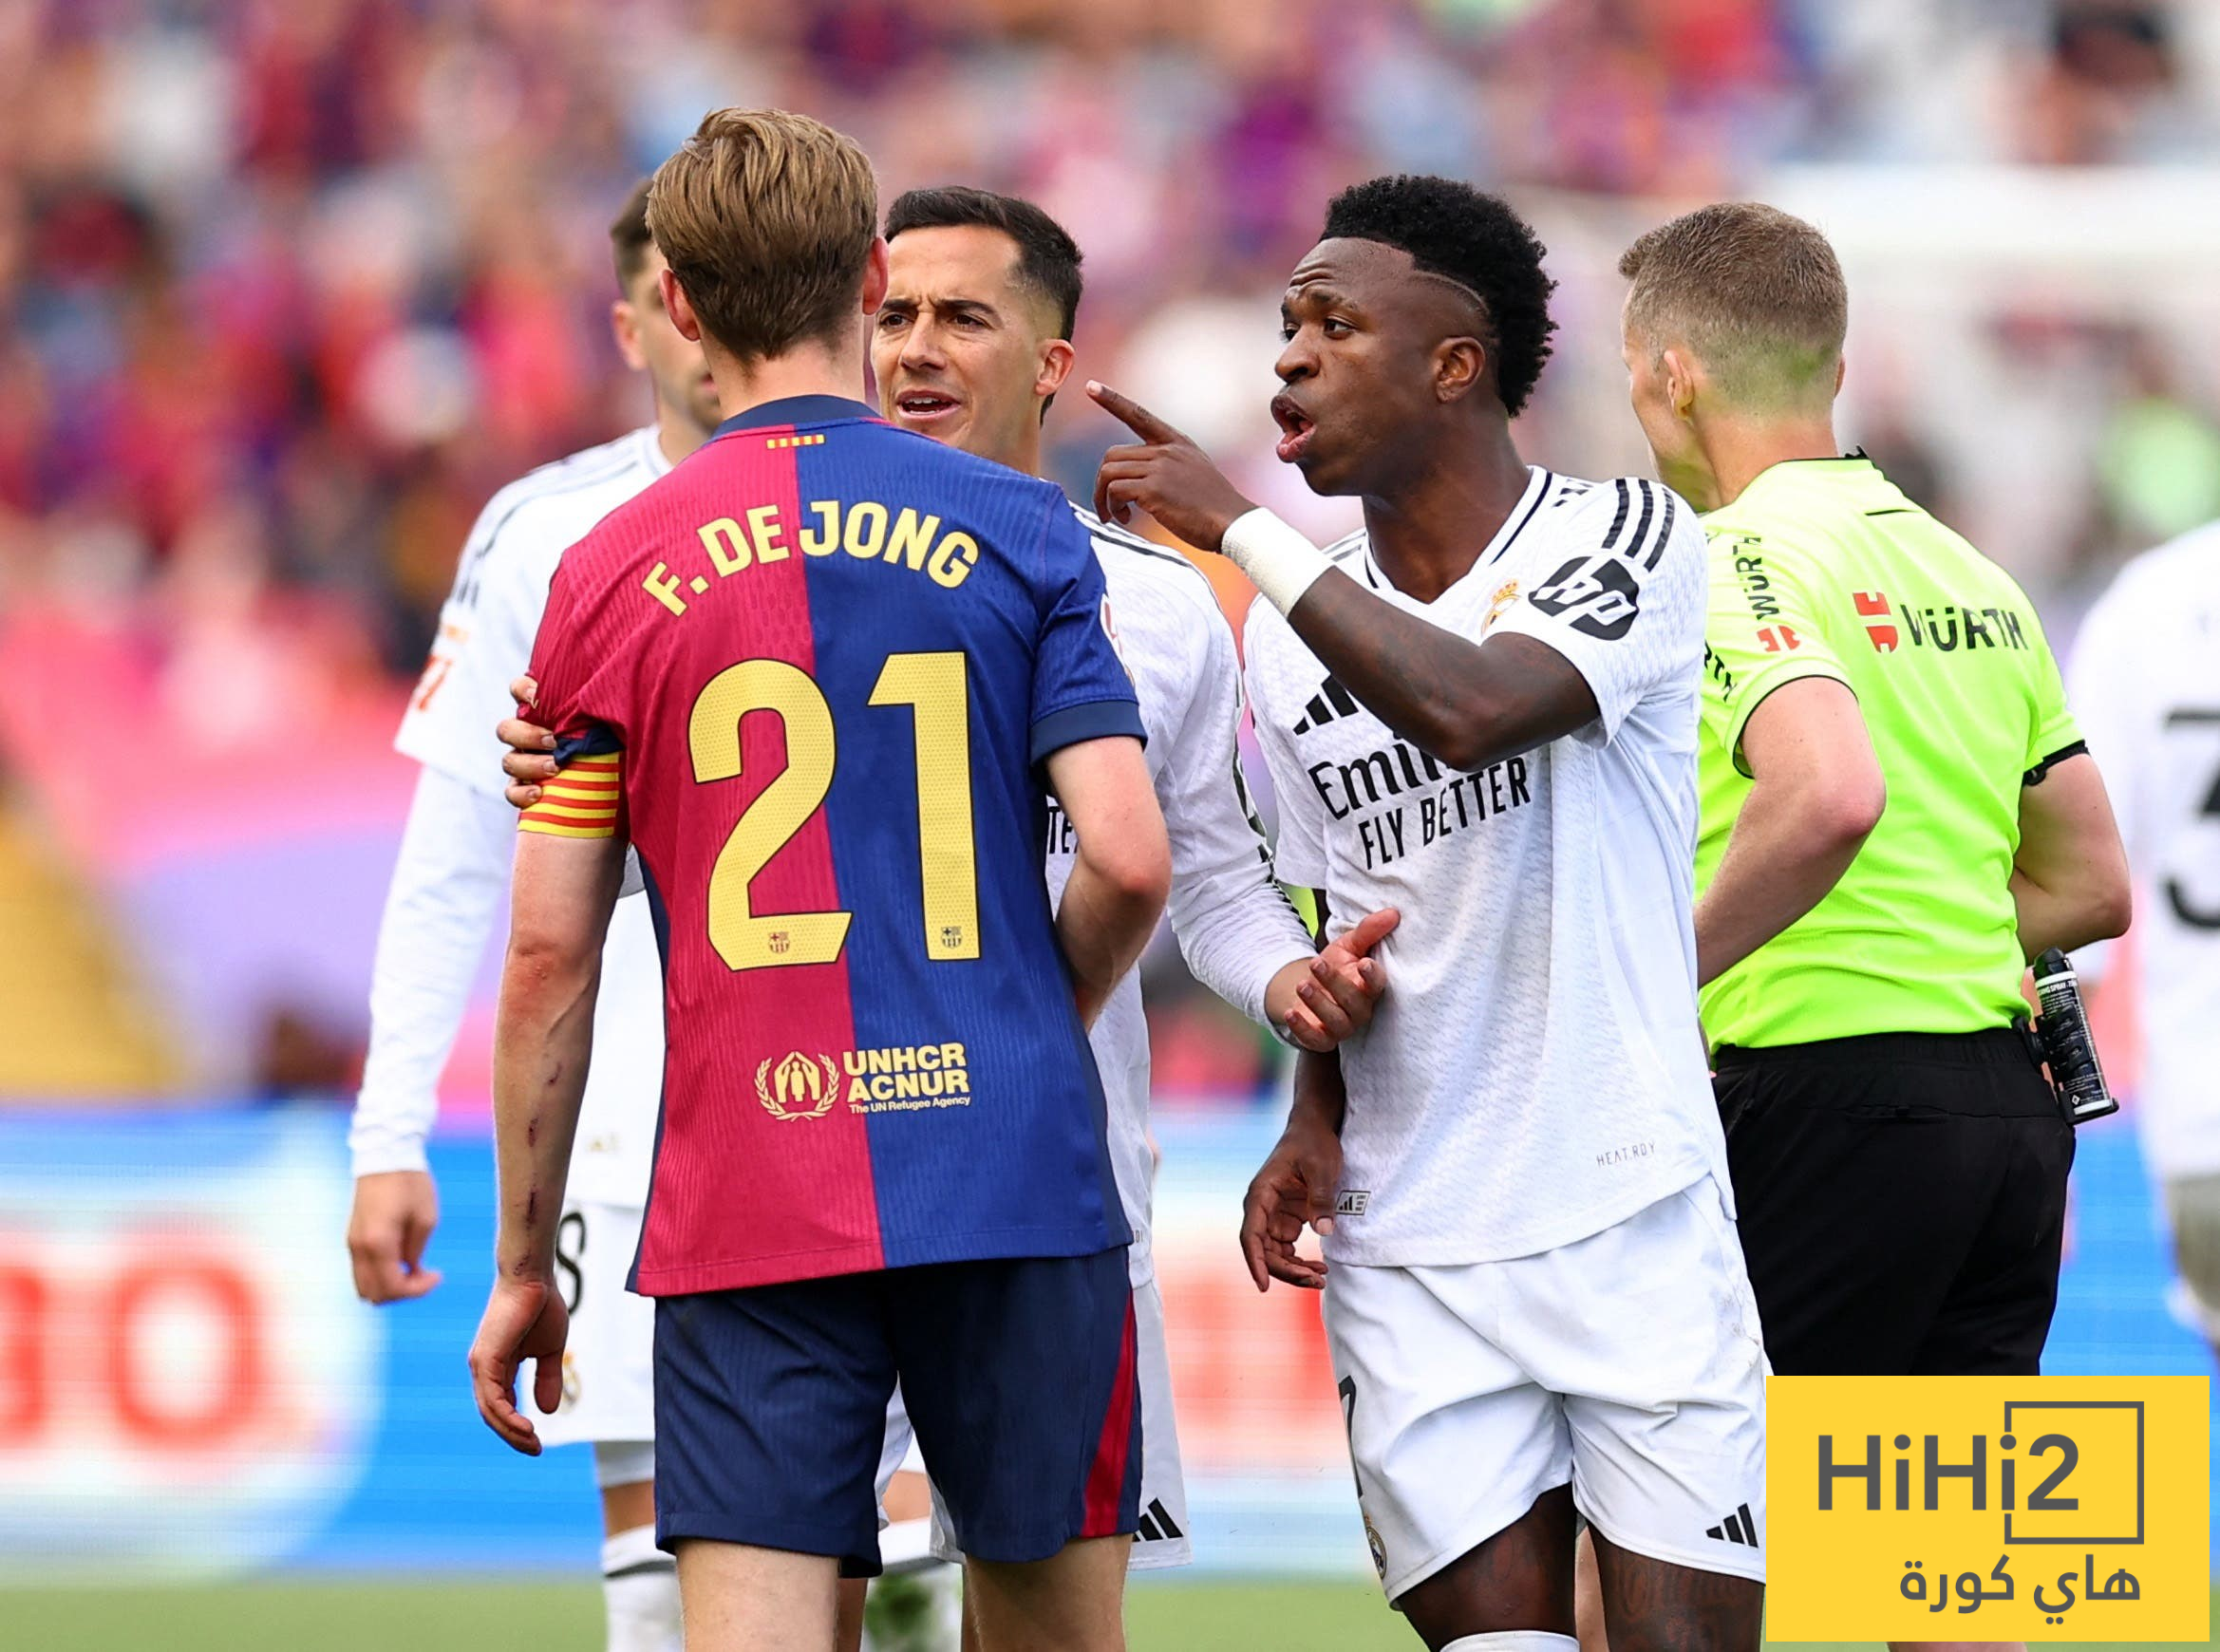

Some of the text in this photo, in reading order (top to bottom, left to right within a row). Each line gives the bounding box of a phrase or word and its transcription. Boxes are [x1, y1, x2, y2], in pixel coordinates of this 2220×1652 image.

[642, 500, 979, 617] F. DE JONG
[1899, 604, 2029, 652] WÜRTH
[687, 651, 982, 972] 21
[1358, 757, 1531, 870] FLY BETTER
[843, 1042, 966, 1077] UNHCR
[847, 1069, 969, 1102] ACNUR
[849, 1096, 970, 1114] The UN Refugee Agency
